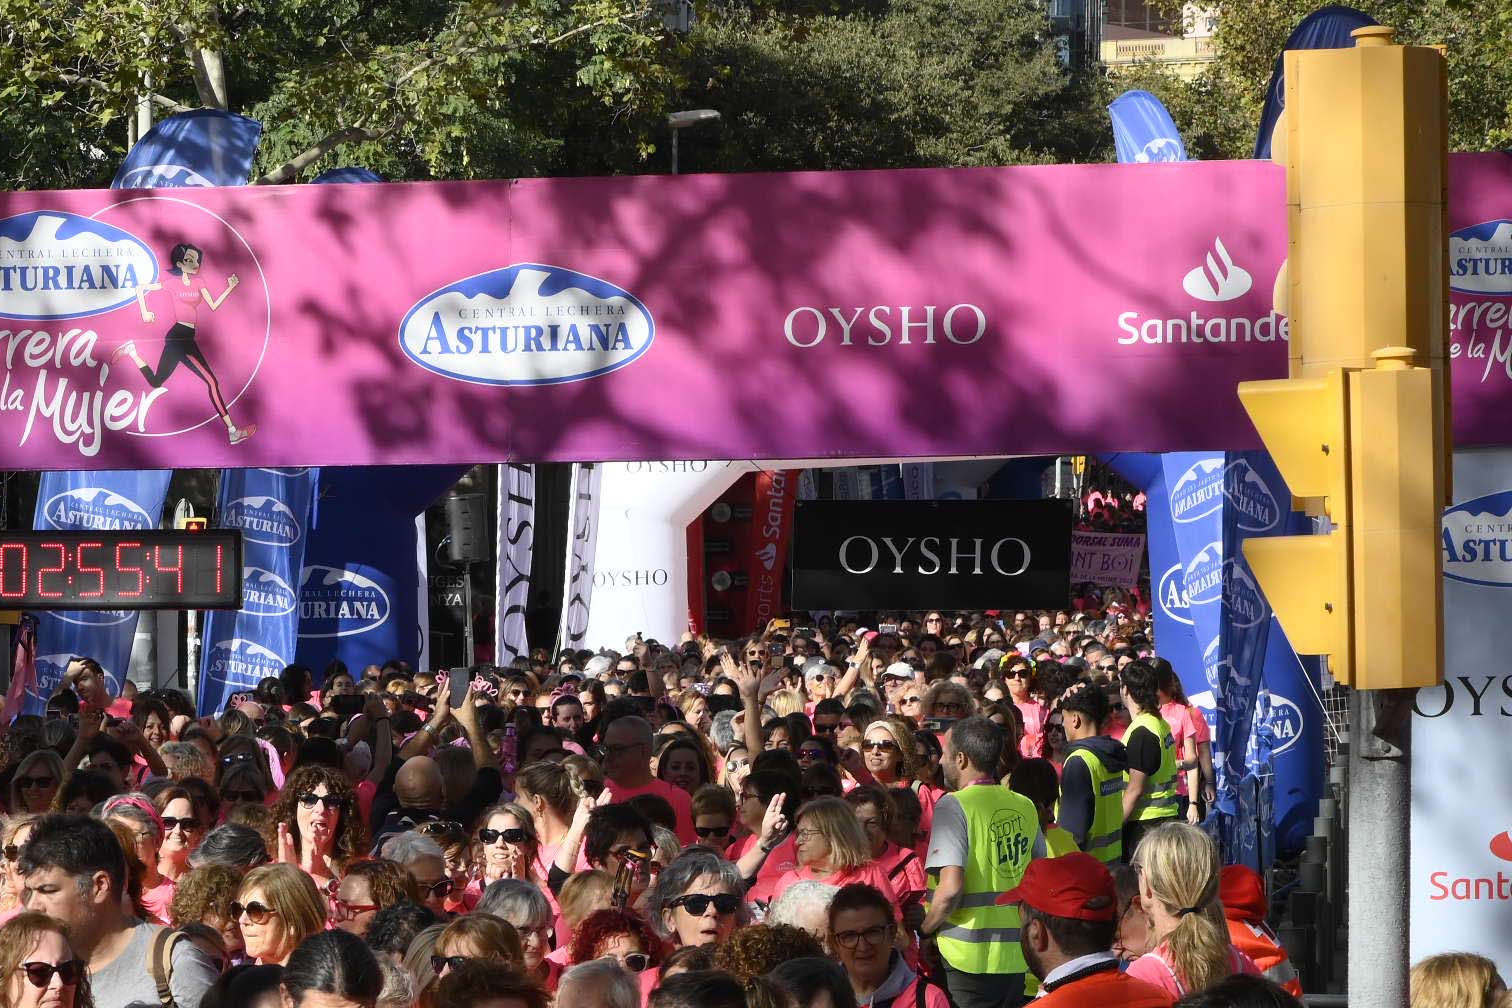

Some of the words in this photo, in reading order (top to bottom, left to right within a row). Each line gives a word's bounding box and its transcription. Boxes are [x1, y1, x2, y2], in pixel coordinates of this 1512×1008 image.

[458, 306, 537, 320] CENTRAL
[545, 302, 626, 317] LECHERA
[783, 302, 988, 348] OYSHO
[1117, 310, 1289, 345] Santande
[420, 310, 635, 357] ASTURIANA
[1468, 330, 1486, 359] la
[0, 369, 24, 412] la
[19, 363, 168, 457] Mujer
[838, 535, 1032, 576] OYSHO
[592, 568, 668, 588] OYSHO
[990, 815, 1023, 842] Sport
[996, 832, 1029, 867] Life
